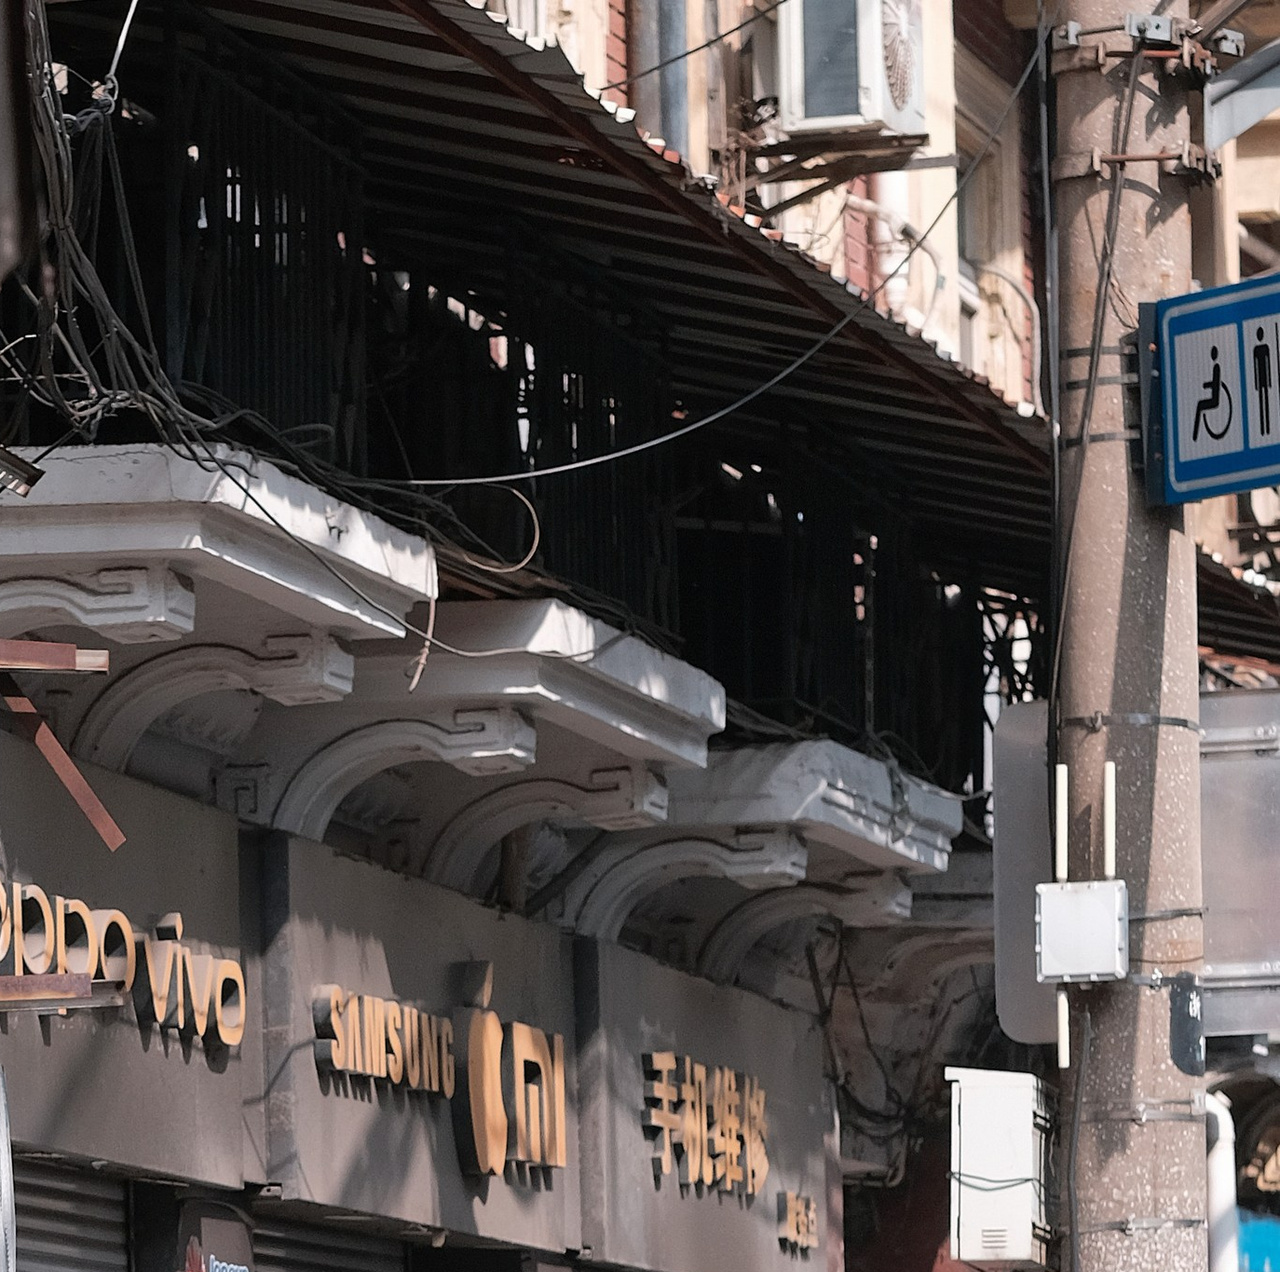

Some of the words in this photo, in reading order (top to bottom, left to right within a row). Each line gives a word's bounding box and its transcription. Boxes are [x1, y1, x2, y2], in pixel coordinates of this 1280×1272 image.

[145, 911, 247, 1047] vivo
[329, 984, 456, 1101] SAMSUNG
[651, 1051, 770, 1197] 手机维修
